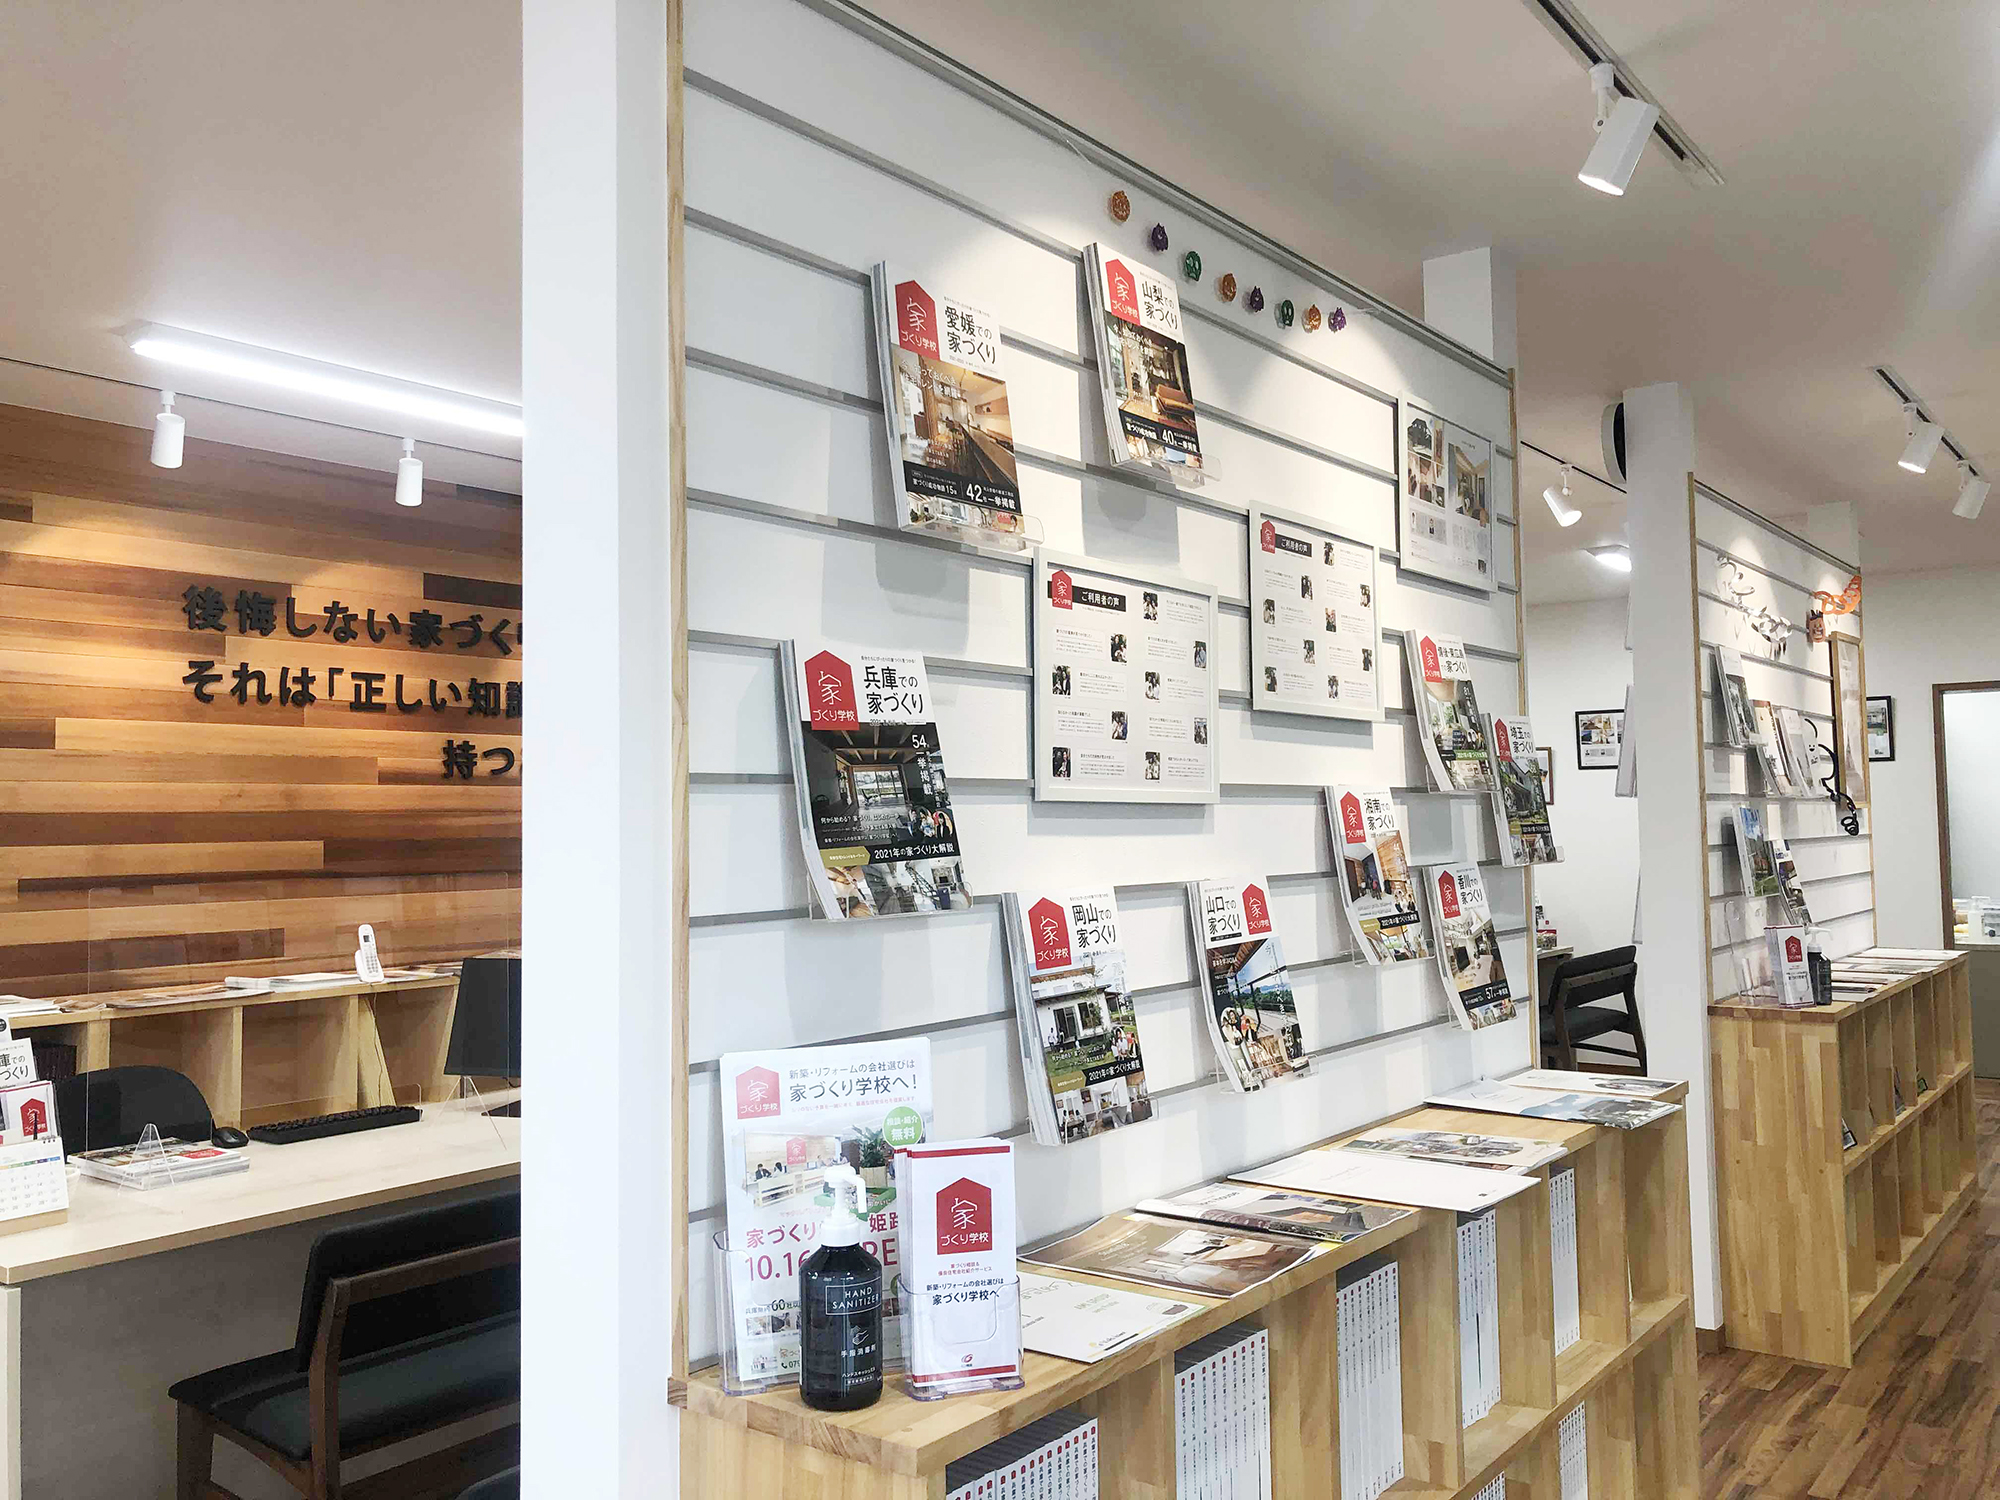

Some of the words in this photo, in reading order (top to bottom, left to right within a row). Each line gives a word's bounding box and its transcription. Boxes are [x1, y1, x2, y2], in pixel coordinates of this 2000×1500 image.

[1142, 280, 1175, 309] 山梨での
[944, 305, 993, 340] 愛媛での
[1144, 301, 1178, 330] 家づくり
[901, 329, 938, 353] づくり学校
[947, 331, 996, 365] 家づくり
[1081, 591, 1120, 608] ご利用者の声
[818, 671, 842, 705] 家
[864, 665, 918, 691] 兵庫での
[866, 691, 924, 715] 家づくり
[812, 709, 856, 723] づくり学校
[1512, 740, 1534, 754] 家づくり
[442, 739, 522, 780] 持つ
[1367, 814, 1395, 832] 家づくり
[1206, 895, 1238, 916] 山口での
[1460, 888, 1483, 906] 家づくり
[1071, 903, 1112, 926] 岡山での
[1208, 913, 1241, 936] 家づくり
[1040, 915, 1060, 946] 家
[1076, 924, 1117, 949] 家づくり
[1037, 947, 1070, 962] づくり学校
[789, 1059, 915, 1080] 新築・リフォームの会社選びは
[789, 1073, 918, 1103] 家づくり学校へ!
[739, 1102, 778, 1115] づくり学校
[890, 1126, 915, 1142] 無料
[951, 1197, 978, 1230] 家
[746, 1220, 816, 1249] 家づくり
[940, 1232, 989, 1247] づくり学校
[844, 1286, 873, 1299] HAND
[926, 1278, 1004, 1292] 新築・リフォームの会社選びは
[832, 1293, 880, 1310] SANITIZER
[932, 1289, 1000, 1306] 家づくり学校へ
